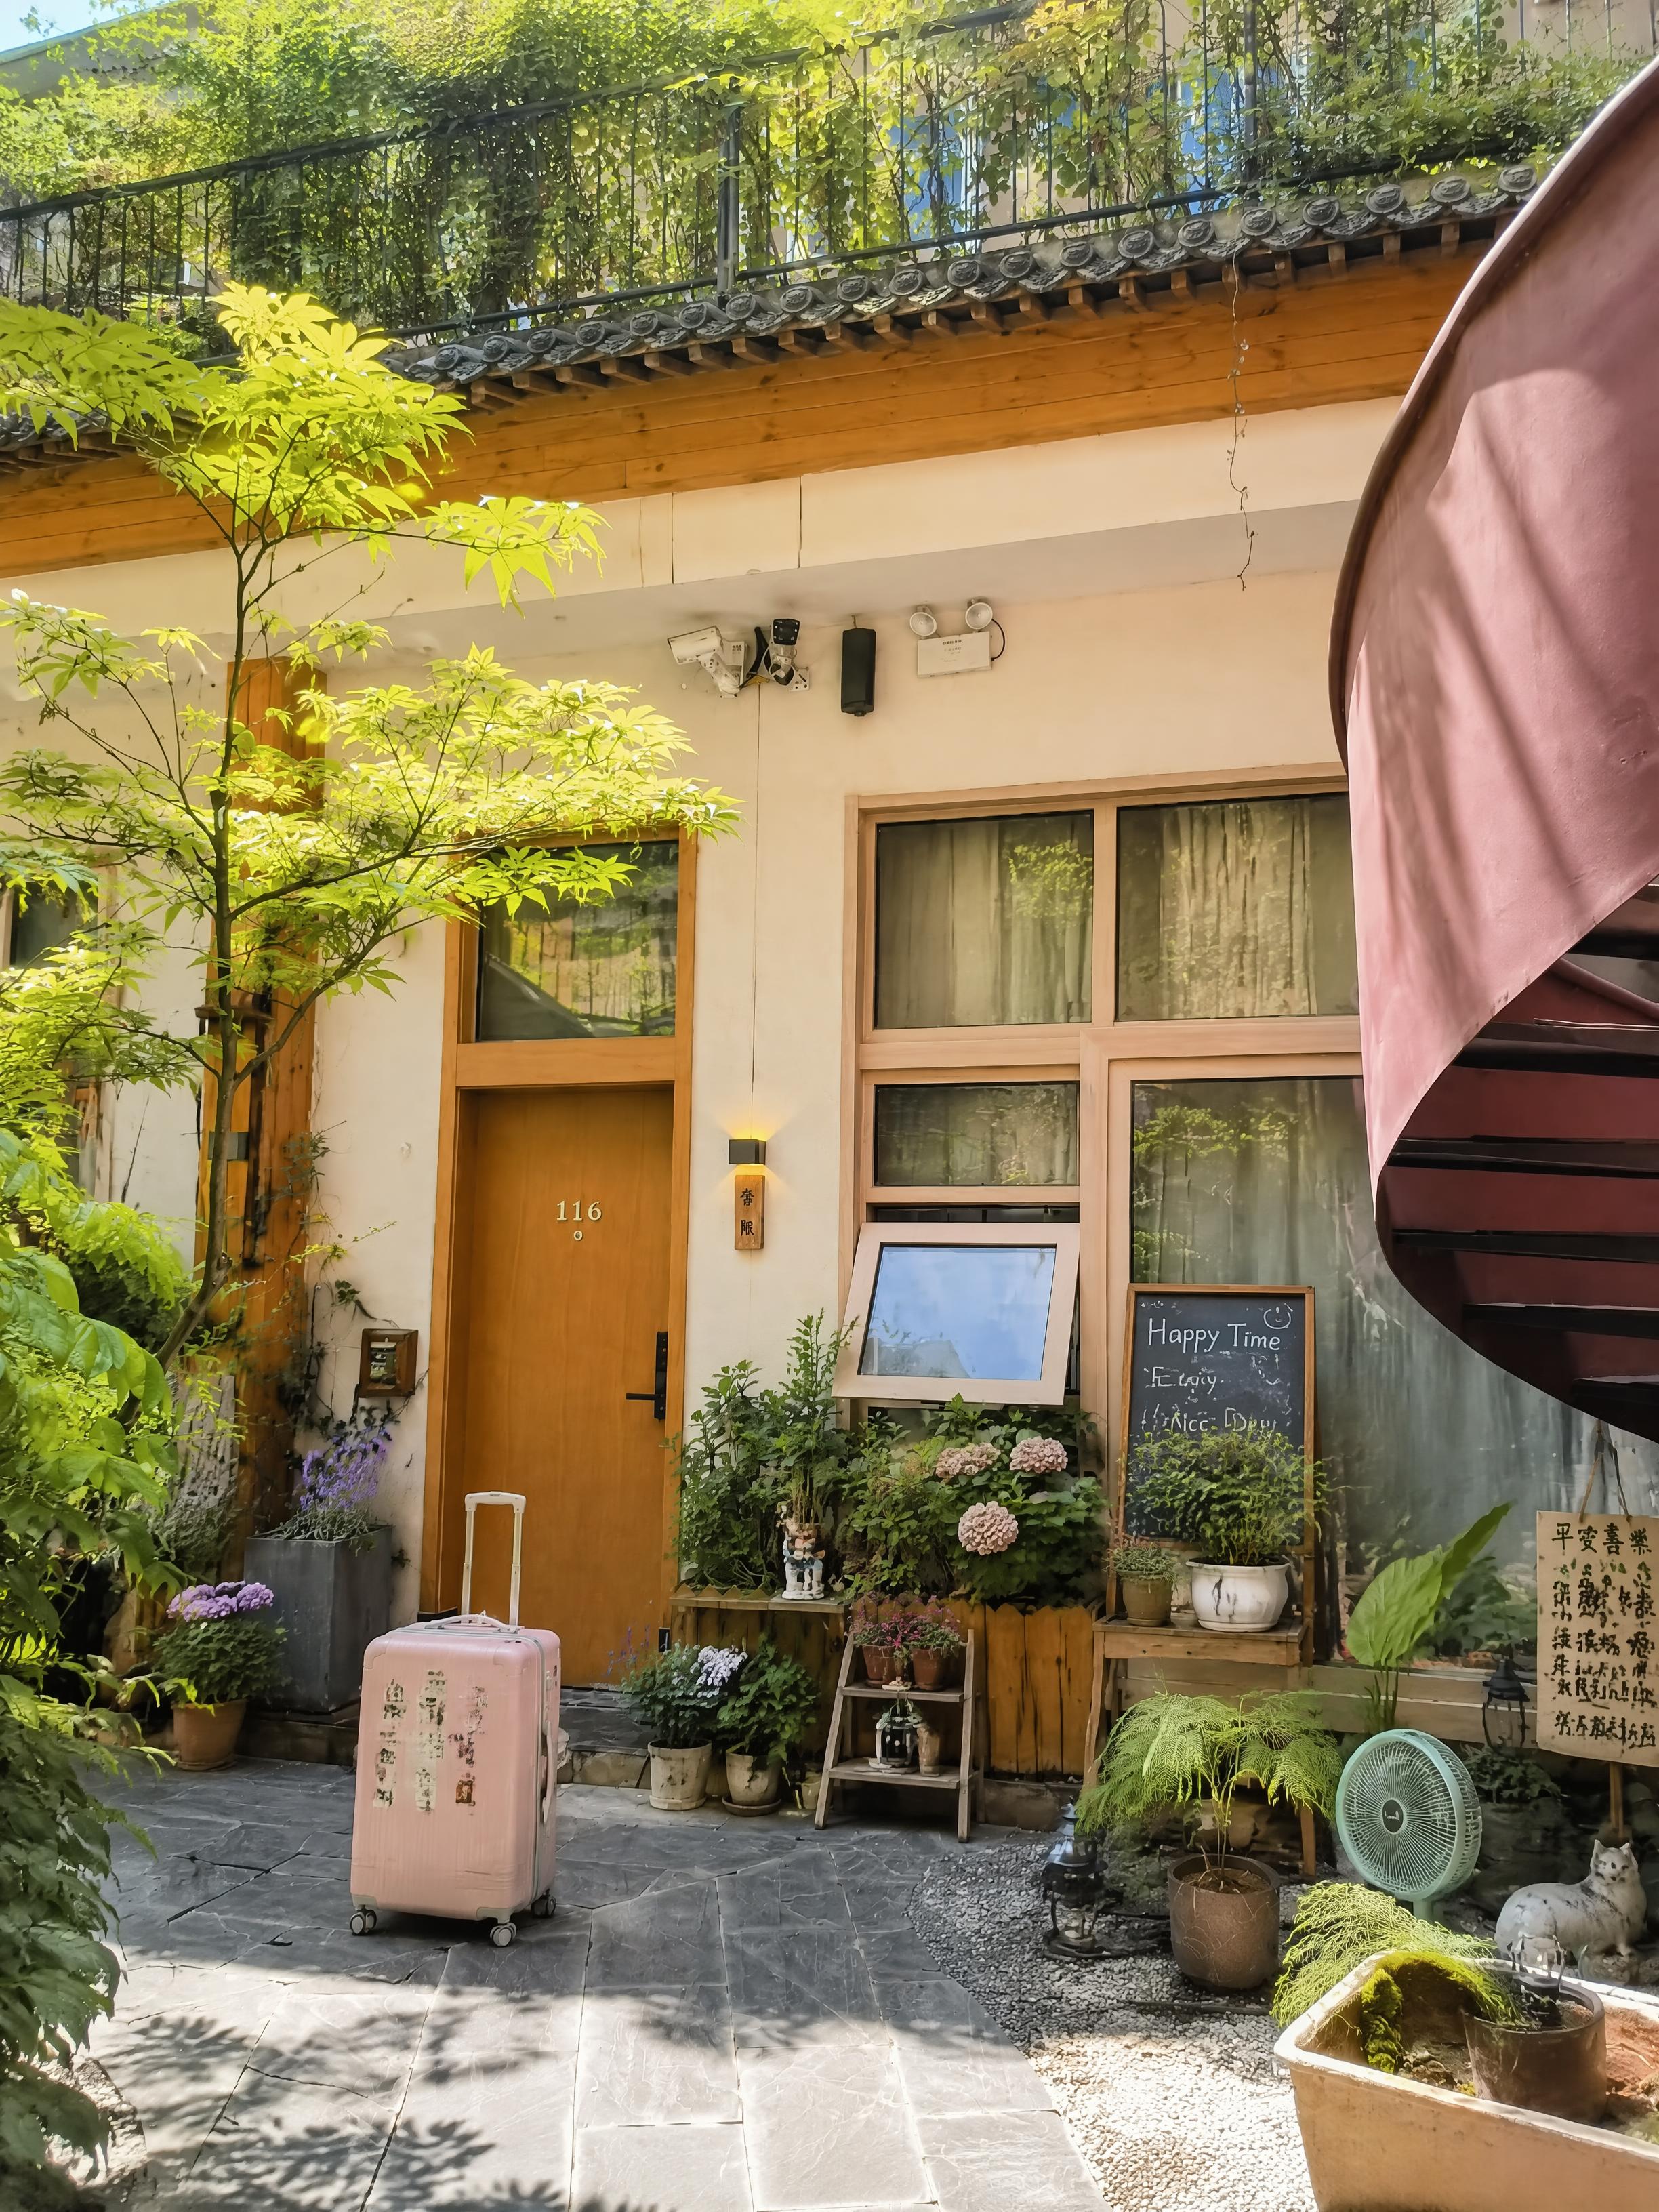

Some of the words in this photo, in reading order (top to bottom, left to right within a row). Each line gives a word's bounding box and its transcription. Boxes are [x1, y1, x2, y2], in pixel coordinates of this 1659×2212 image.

[556, 1200, 602, 1221] 116
[1148, 1318, 1220, 1353] Happy
[1227, 1322, 1281, 1351] Time
